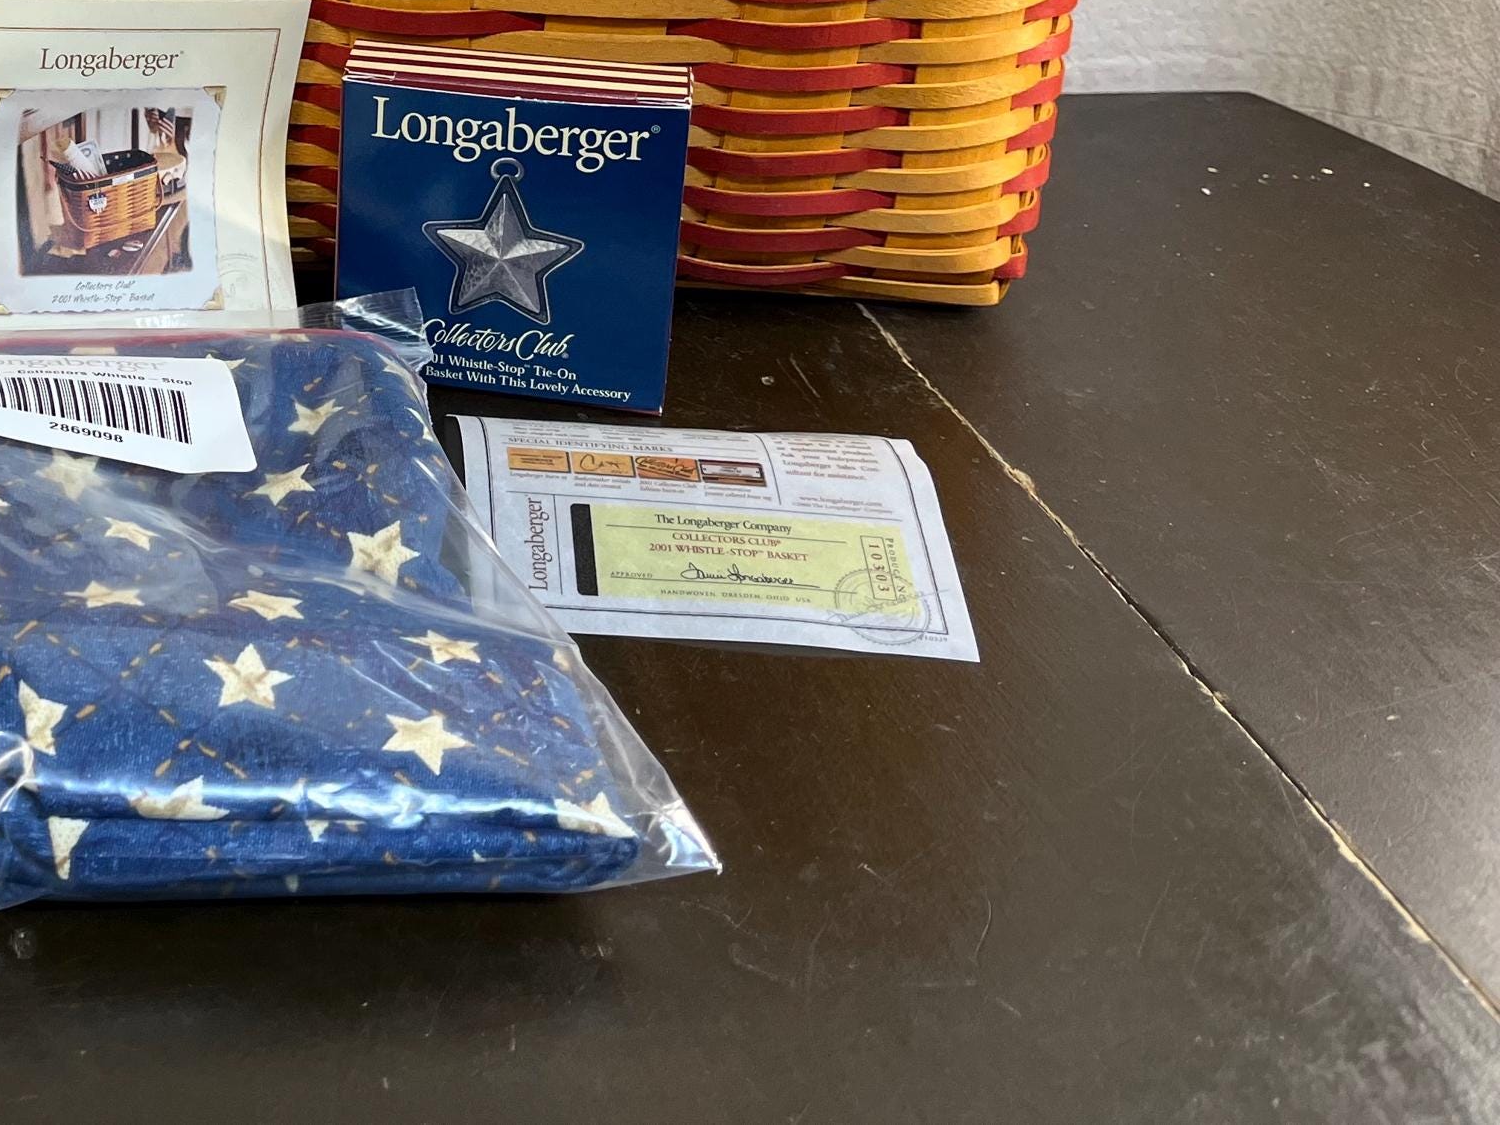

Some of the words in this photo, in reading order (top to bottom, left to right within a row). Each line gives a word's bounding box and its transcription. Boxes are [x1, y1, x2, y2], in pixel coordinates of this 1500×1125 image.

[74, 280, 113, 291] Collectors
[51, 294, 71, 304] 2001
[128, 292, 156, 303] Basket
[422, 318, 518, 354] Collectors
[92, 371, 146, 381] Whistle
[161, 377, 193, 386] Stop
[532, 364, 578, 381] Tie-On
[424, 364, 465, 381] Basket
[466, 370, 497, 386] With
[500, 374, 528, 390] This
[529, 378, 570, 396] Lovely
[570, 383, 632, 403] Accessory
[48, 420, 125, 444] 2869098
[507, 436, 550, 445] SPECIAL
[555, 439, 629, 450] IDENTIFYING
[632, 444, 674, 452] MARKS
[653, 513, 675, 524] The
[676, 515, 741, 531] Longaberger
[742, 520, 793, 535] Company
[671, 531, 746, 545] COLLECTORS
[648, 542, 673, 553] 2001
[766, 551, 809, 562] BASKET
[867, 543, 891, 593] 10303
